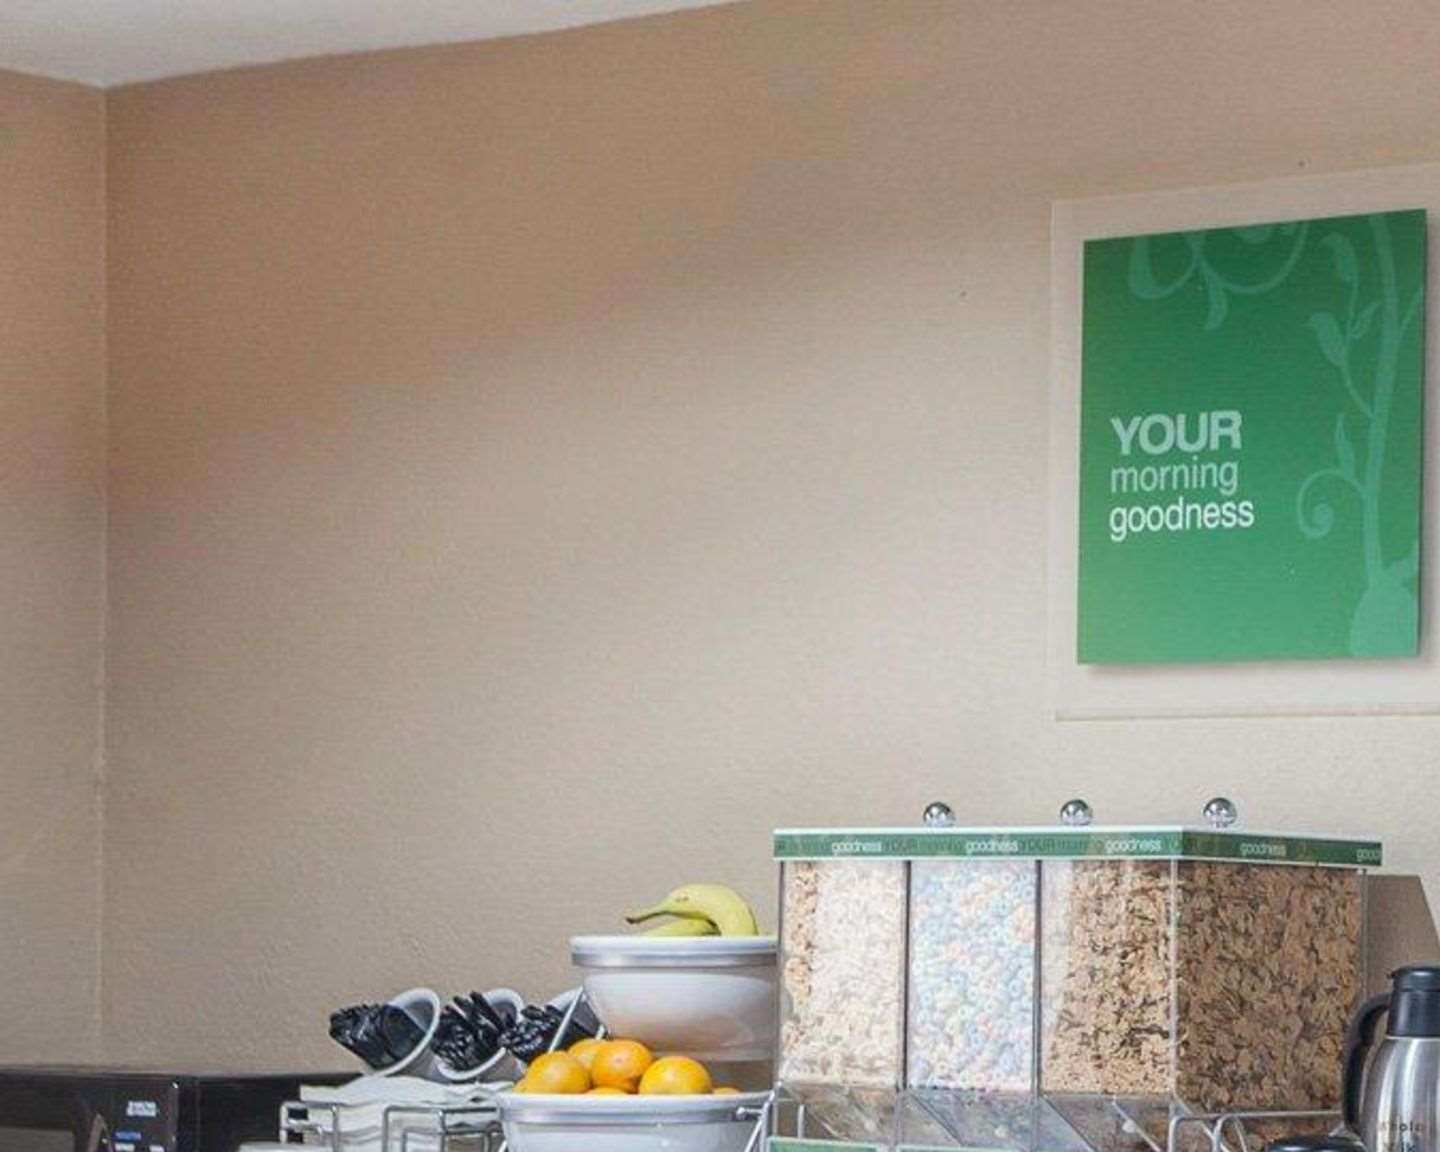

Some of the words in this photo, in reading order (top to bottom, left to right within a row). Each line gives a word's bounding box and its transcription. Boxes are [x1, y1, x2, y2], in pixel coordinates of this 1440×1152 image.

[1110, 410, 1242, 455] YOUR
[1110, 455, 1239, 496] morning
[1109, 496, 1255, 542] goodness
[965, 840, 1018, 856] goodness
[1104, 839, 1161, 855] goodness
